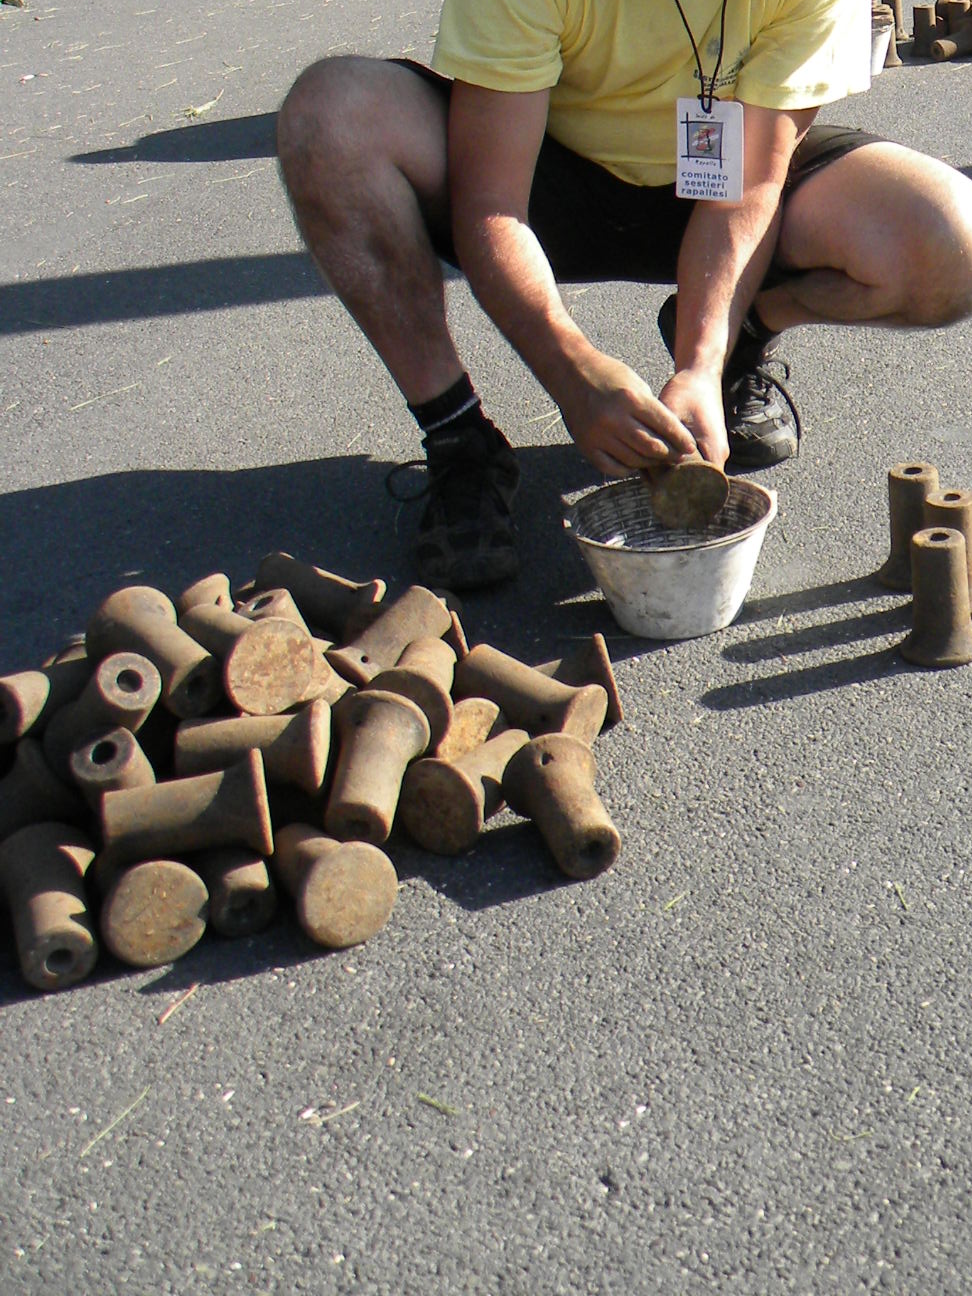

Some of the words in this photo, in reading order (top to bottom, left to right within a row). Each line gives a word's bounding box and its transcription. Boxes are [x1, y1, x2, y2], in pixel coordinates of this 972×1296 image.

[681, 171, 729, 181] comitato
[684, 179, 726, 190] sestieri
[680, 188, 729, 198] rapallesi
